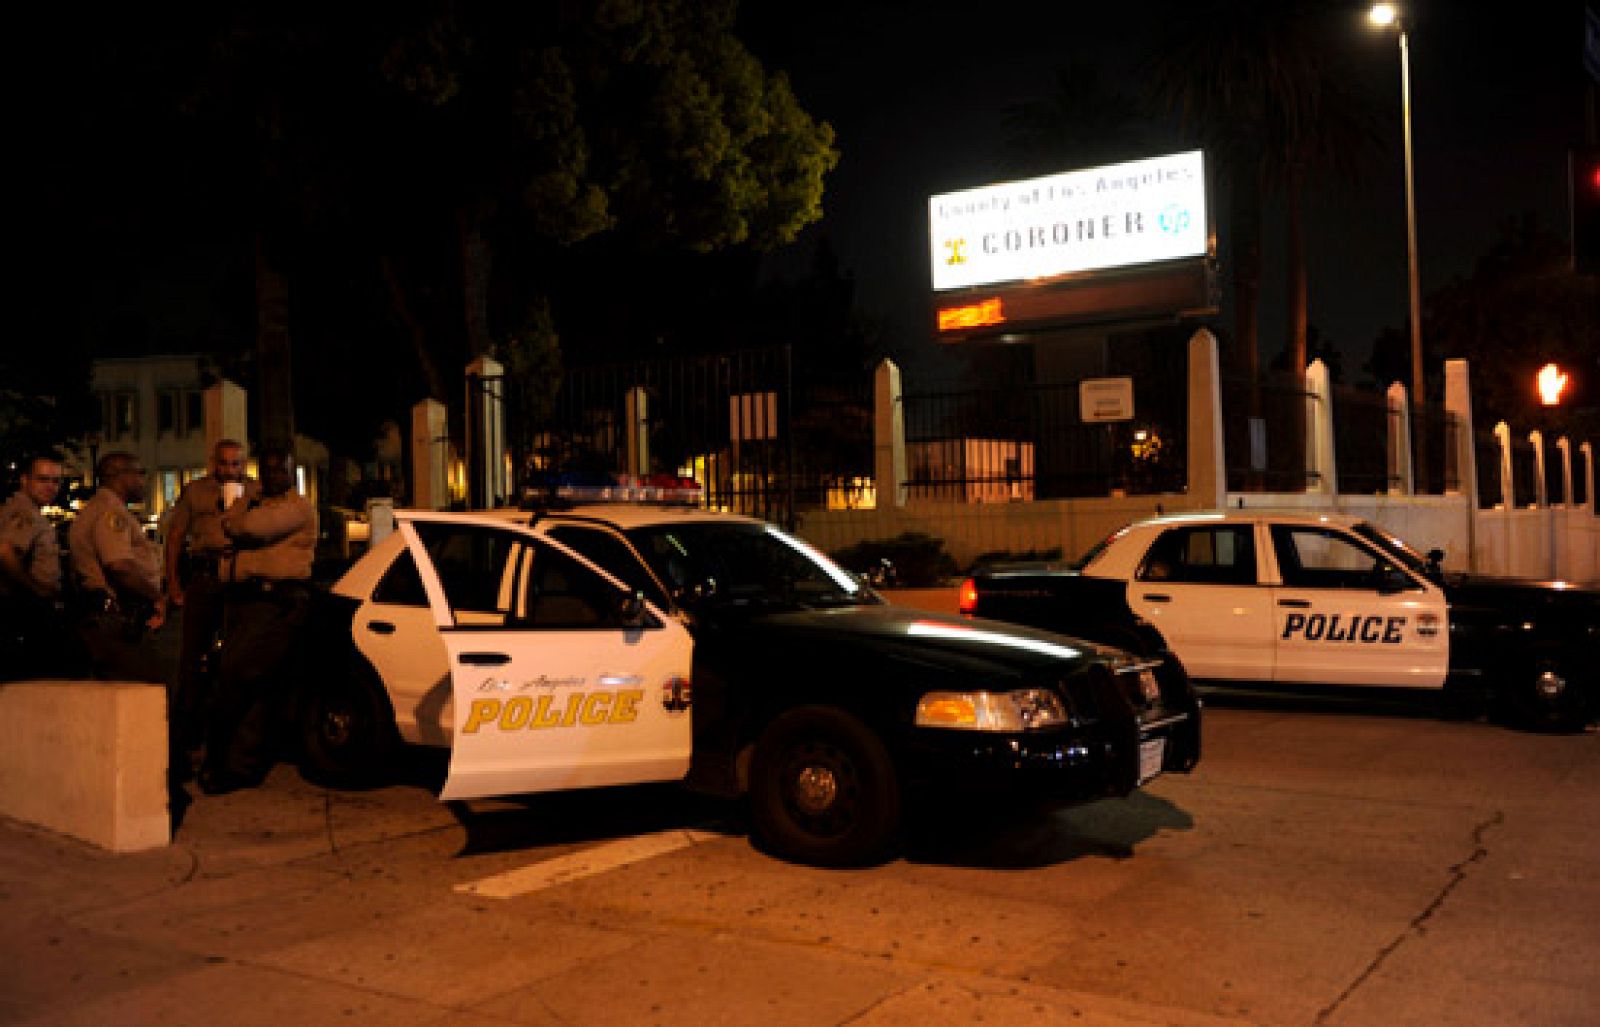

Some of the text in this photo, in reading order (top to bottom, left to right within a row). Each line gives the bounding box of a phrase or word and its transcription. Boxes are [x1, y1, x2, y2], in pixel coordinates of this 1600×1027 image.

[982, 211, 1145, 255] CORONER
[1281, 613, 1408, 643] POLICE
[461, 689, 644, 734] POLICE
